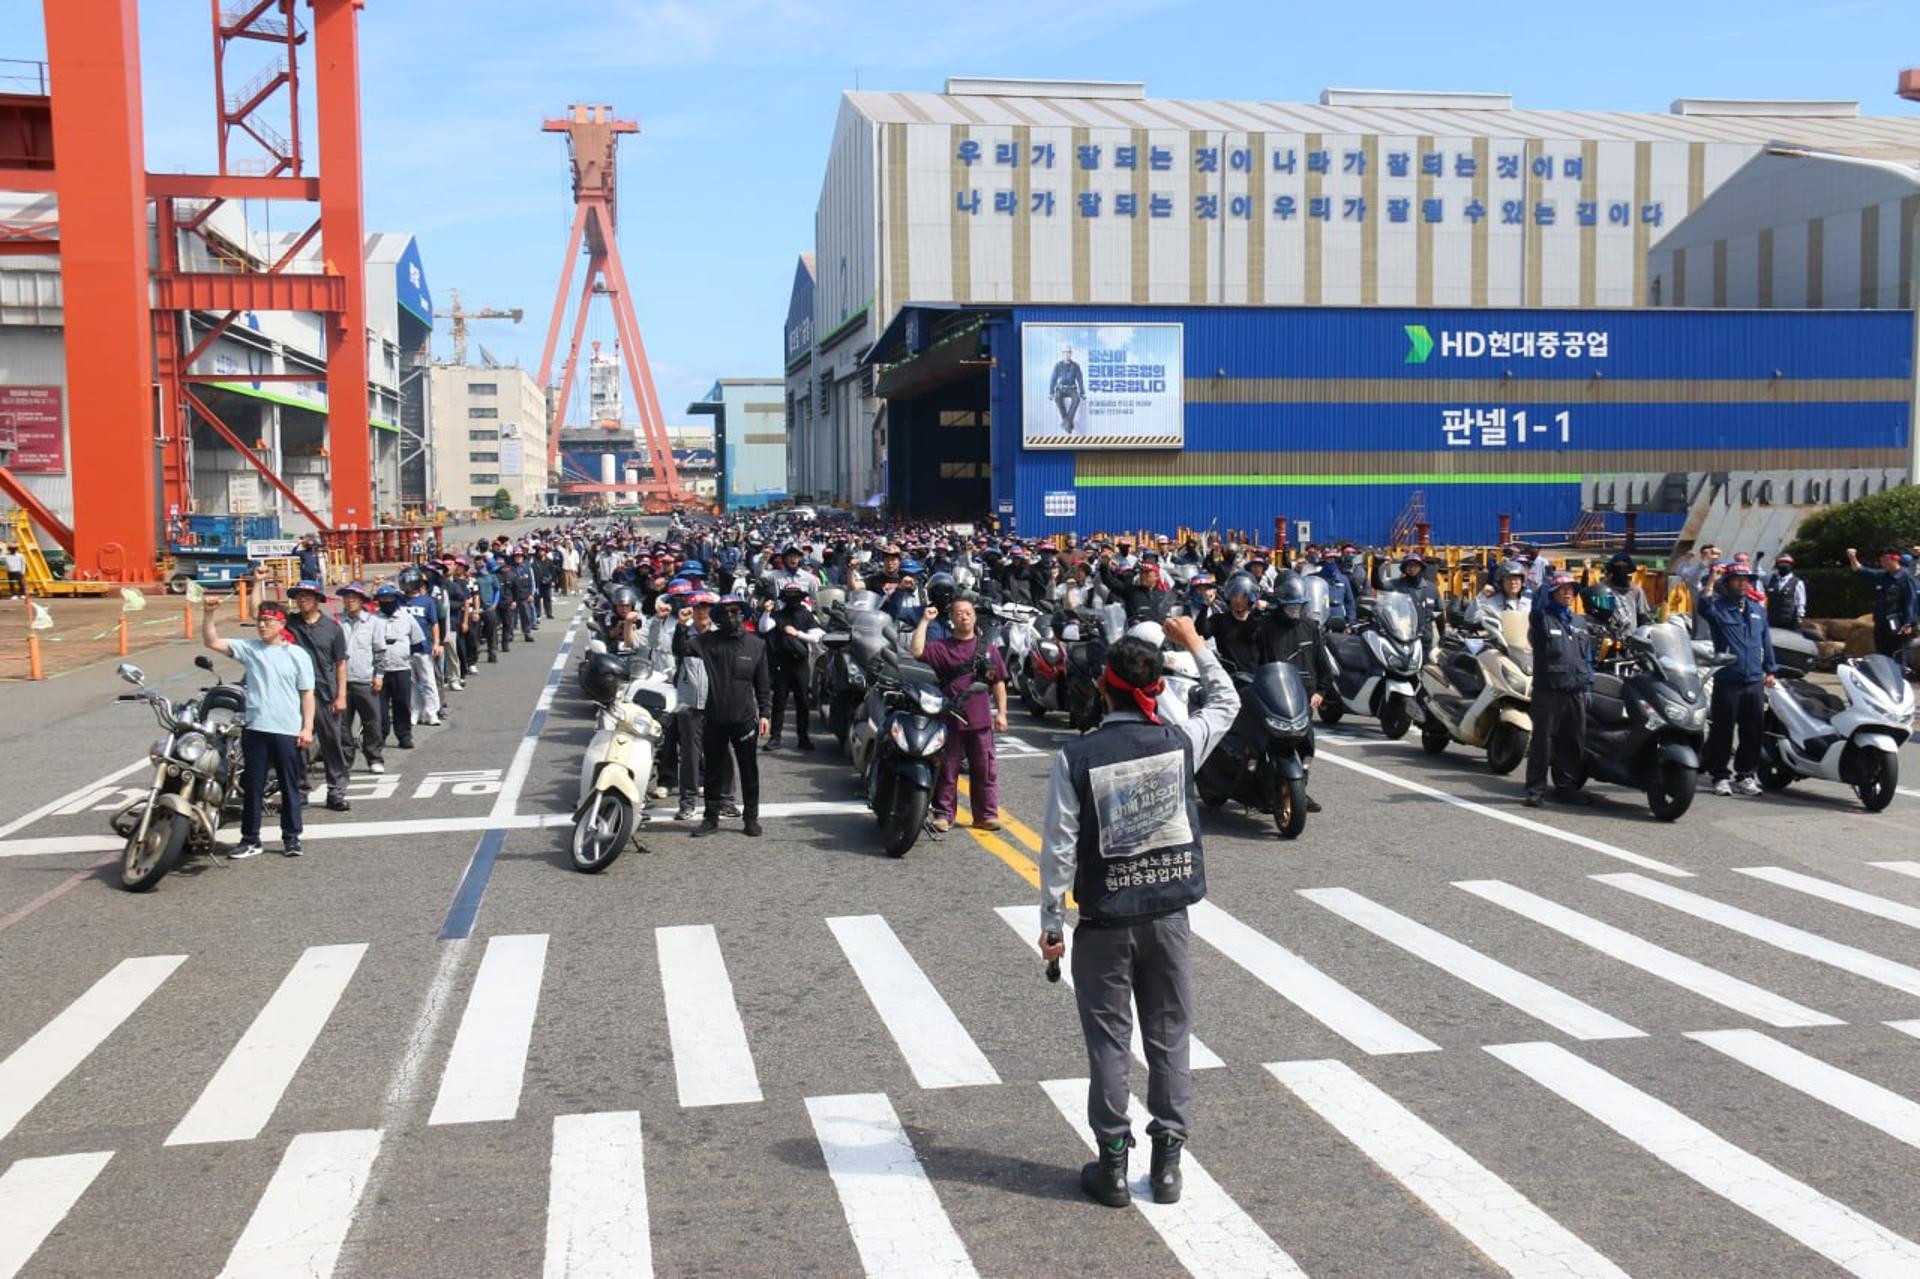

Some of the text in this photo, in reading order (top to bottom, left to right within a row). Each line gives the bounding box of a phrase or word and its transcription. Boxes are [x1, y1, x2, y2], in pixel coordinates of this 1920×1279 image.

[957, 139, 1584, 180] 우리가 잘되는 것이 나라가 잘되는 것이며
[956, 190, 1056, 216] 나라가
[1077, 192, 1173, 218] 잘되는
[1196, 195, 1252, 220] 것이
[1273, 195, 1367, 221] 우리가
[1440, 331, 1609, 358] HD현대중공업
[1088, 380, 1166, 393] 주인공입니다
[1105, 865, 1193, 891] 현대중공업지부
